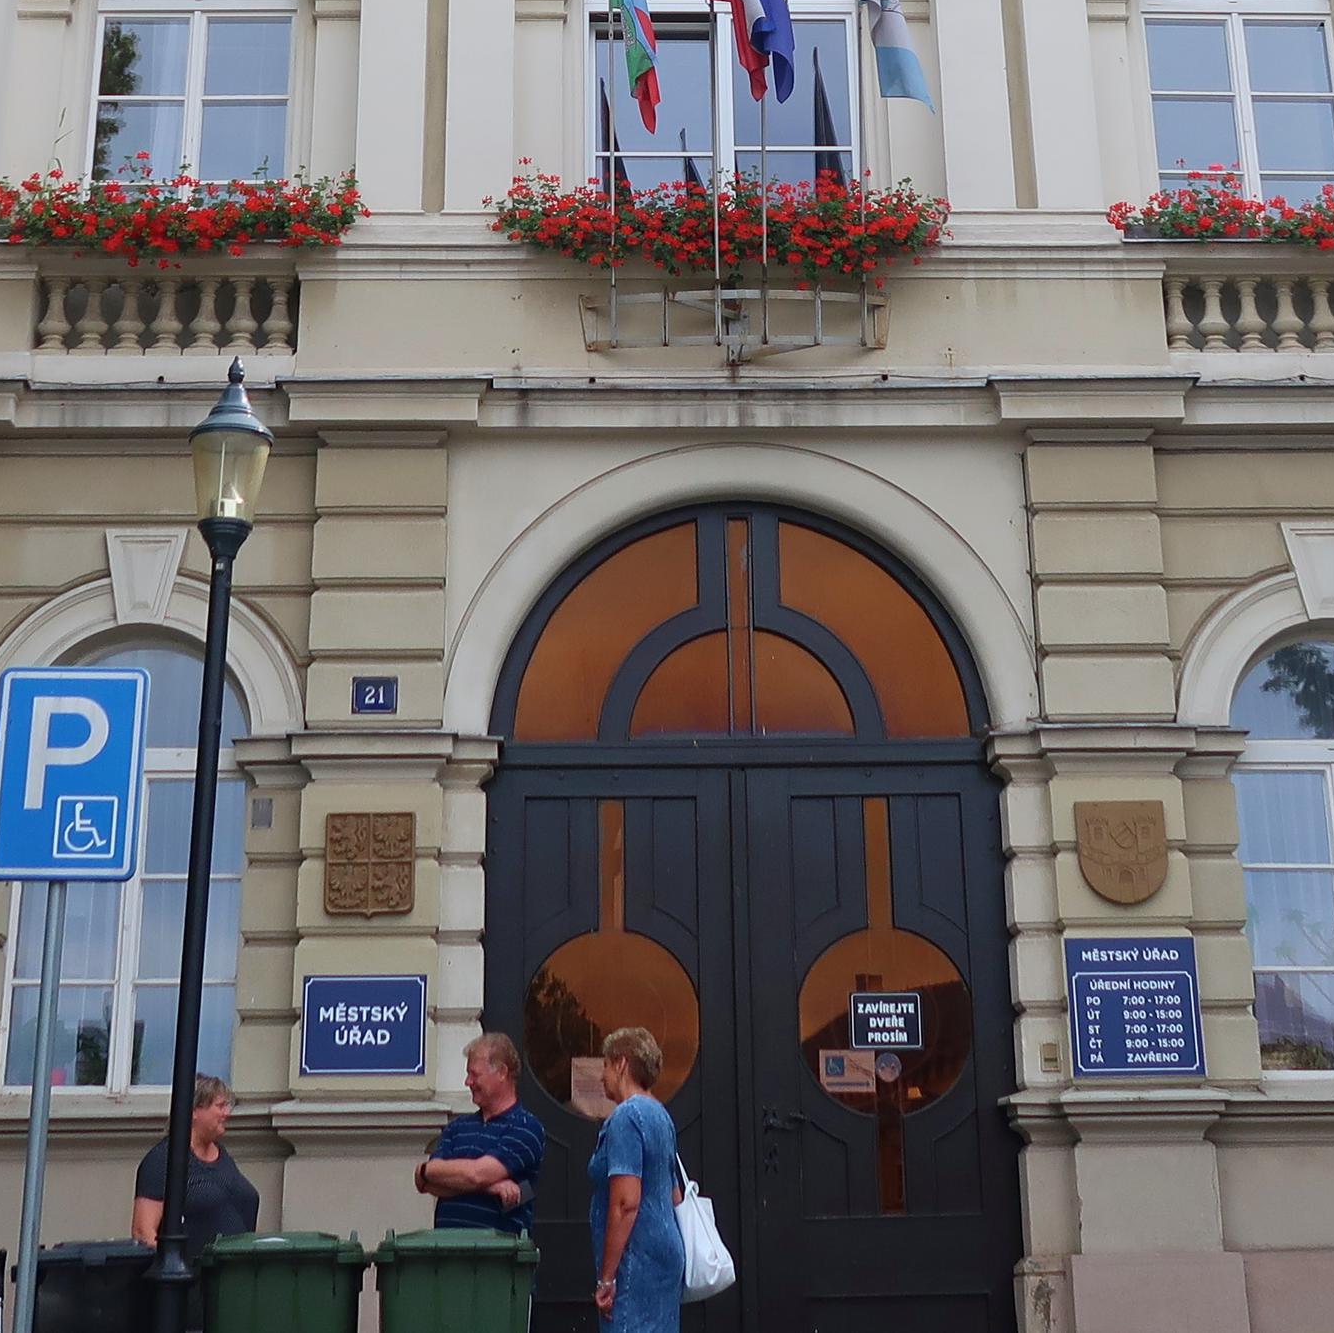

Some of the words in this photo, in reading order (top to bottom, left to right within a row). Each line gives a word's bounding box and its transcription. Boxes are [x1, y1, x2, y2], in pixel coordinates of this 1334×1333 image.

[364, 685, 385, 705] 21
[22, 695, 110, 810] P
[1081, 948, 1140, 962] MĚSTSKÝ
[1142, 947, 1180, 961] ÚŘAD
[1089, 979, 1131, 990] ÚŘEDNÍ
[1133, 980, 1176, 990] HODINY
[1086, 996, 1101, 1006] PO
[1122, 996, 1146, 1006] 7:00
[1154, 995, 1181, 1005] 17:00
[318, 1001, 409, 1023] MĚSTSKÝ
[857, 1001, 915, 1013] ZAVÍREJTE
[1087, 1009, 1101, 1020] ÚT
[1123, 1010, 1147, 1020] 9:00
[1155, 1009, 1182, 1019] 15:00
[869, 1015, 905, 1027] DVEŘE
[334, 1025, 391, 1046] ÚŘAD
[1088, 1025, 1100, 1035] ST
[1124, 1024, 1148, 1034] 7:00
[1156, 1024, 1183, 1034] 17:00
[868, 1030, 907, 1042] PROSÍM
[1089, 1037, 1102, 1049] ČT
[1125, 1038, 1149, 1049] 9:00
[1157, 1038, 1185, 1048] 15:00
[1090, 1052, 1104, 1063] PÁ
[1127, 1051, 1180, 1063] ZAVŘENO
